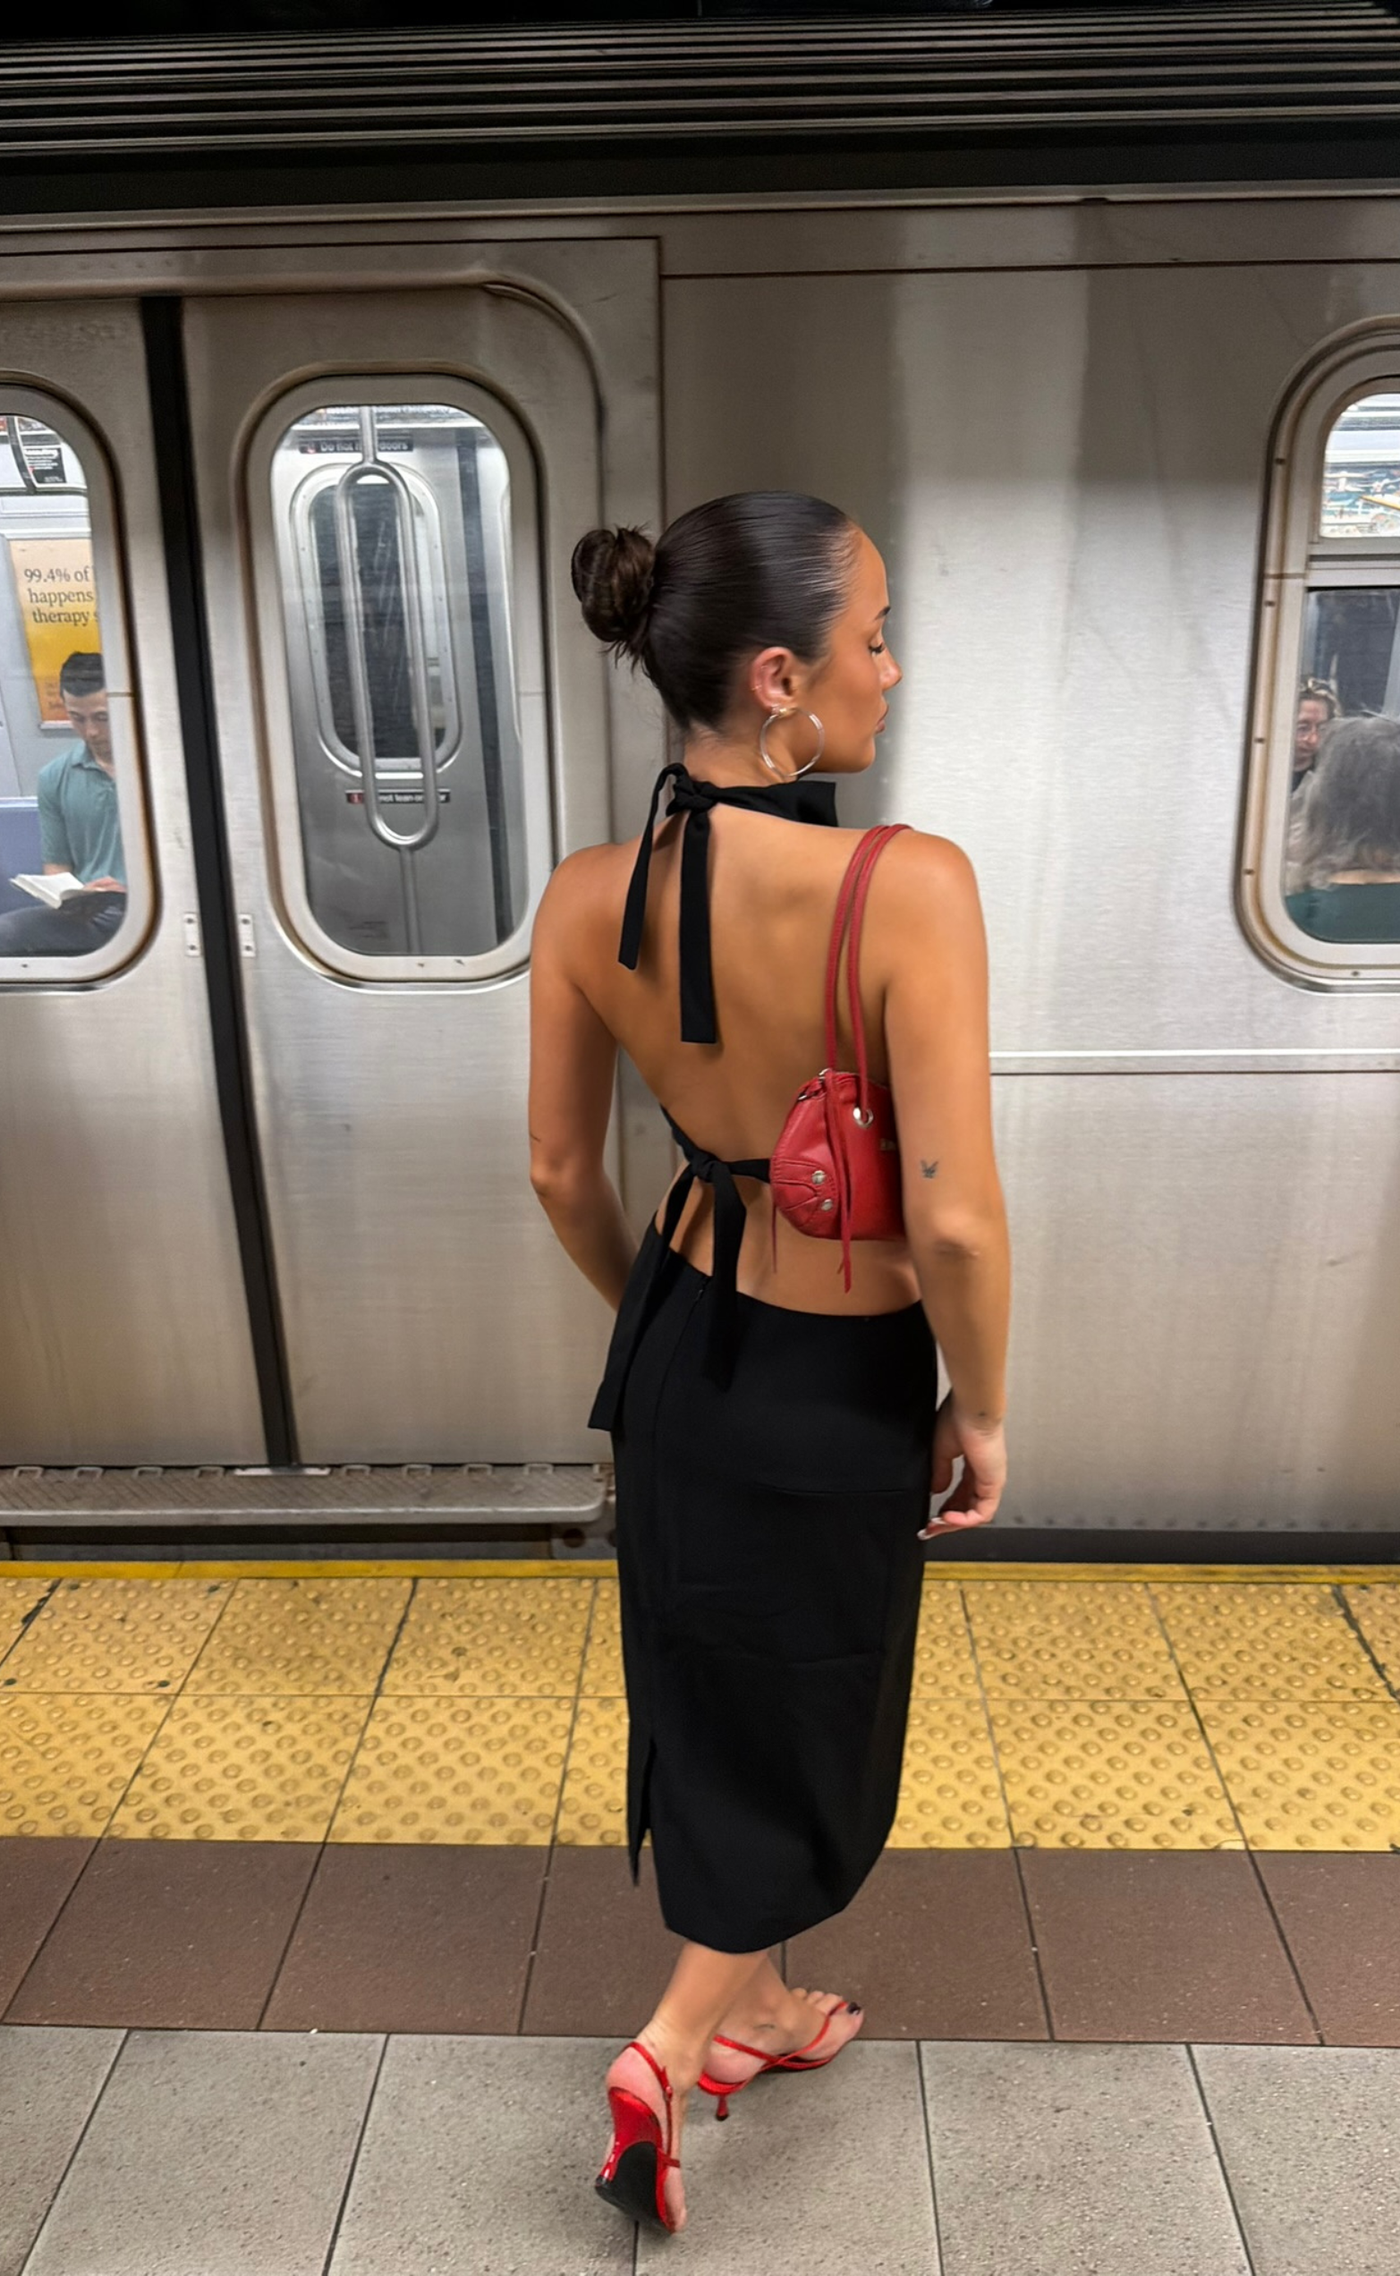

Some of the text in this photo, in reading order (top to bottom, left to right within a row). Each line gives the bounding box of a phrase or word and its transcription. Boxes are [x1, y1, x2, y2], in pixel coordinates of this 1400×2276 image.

[24, 565, 90, 583] 99.4% of
[27, 587, 94, 607] happens
[32, 607, 90, 627] therapy
